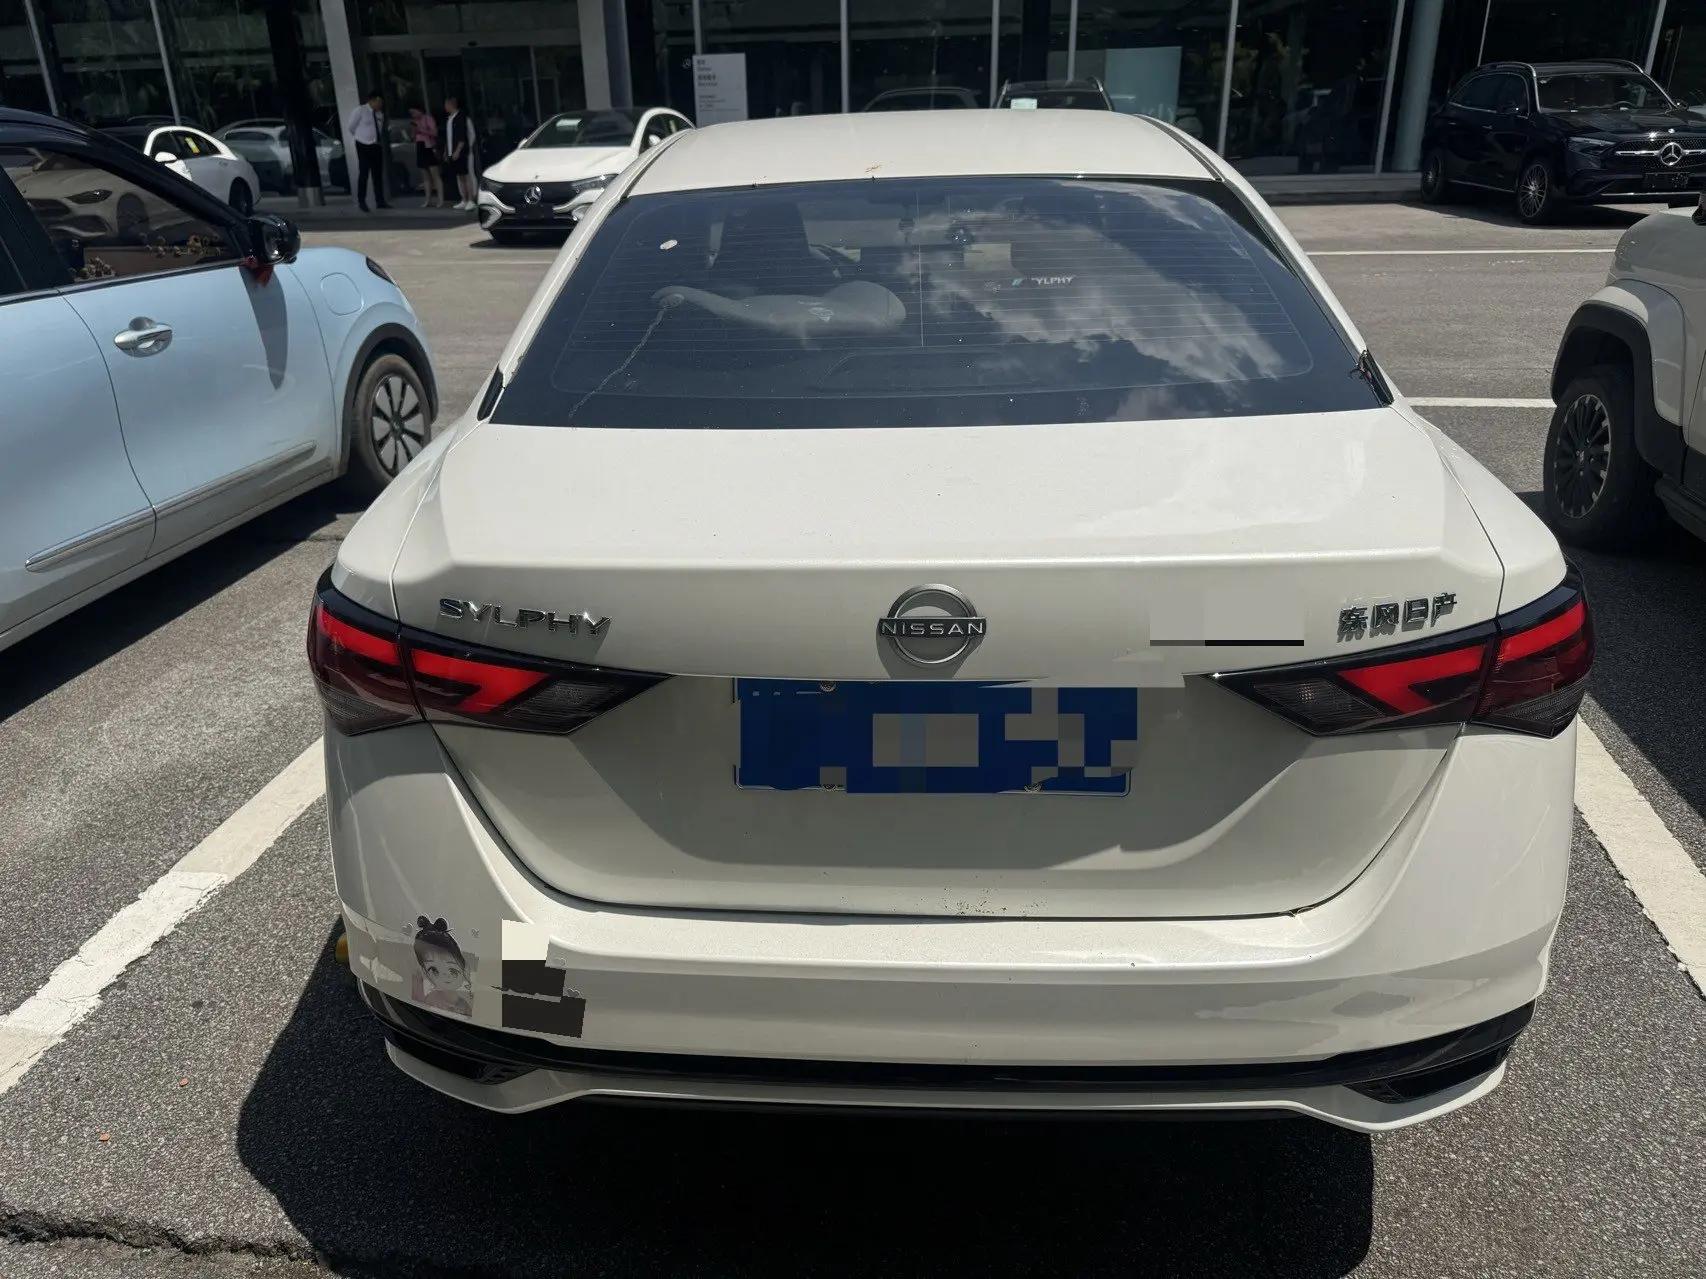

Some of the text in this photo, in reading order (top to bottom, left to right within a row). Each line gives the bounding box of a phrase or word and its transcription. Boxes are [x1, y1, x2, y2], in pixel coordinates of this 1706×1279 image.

[439, 598, 611, 635] SYLPHY
[881, 621, 983, 636] NISSAN
[1339, 592, 1458, 632] 东风日产
